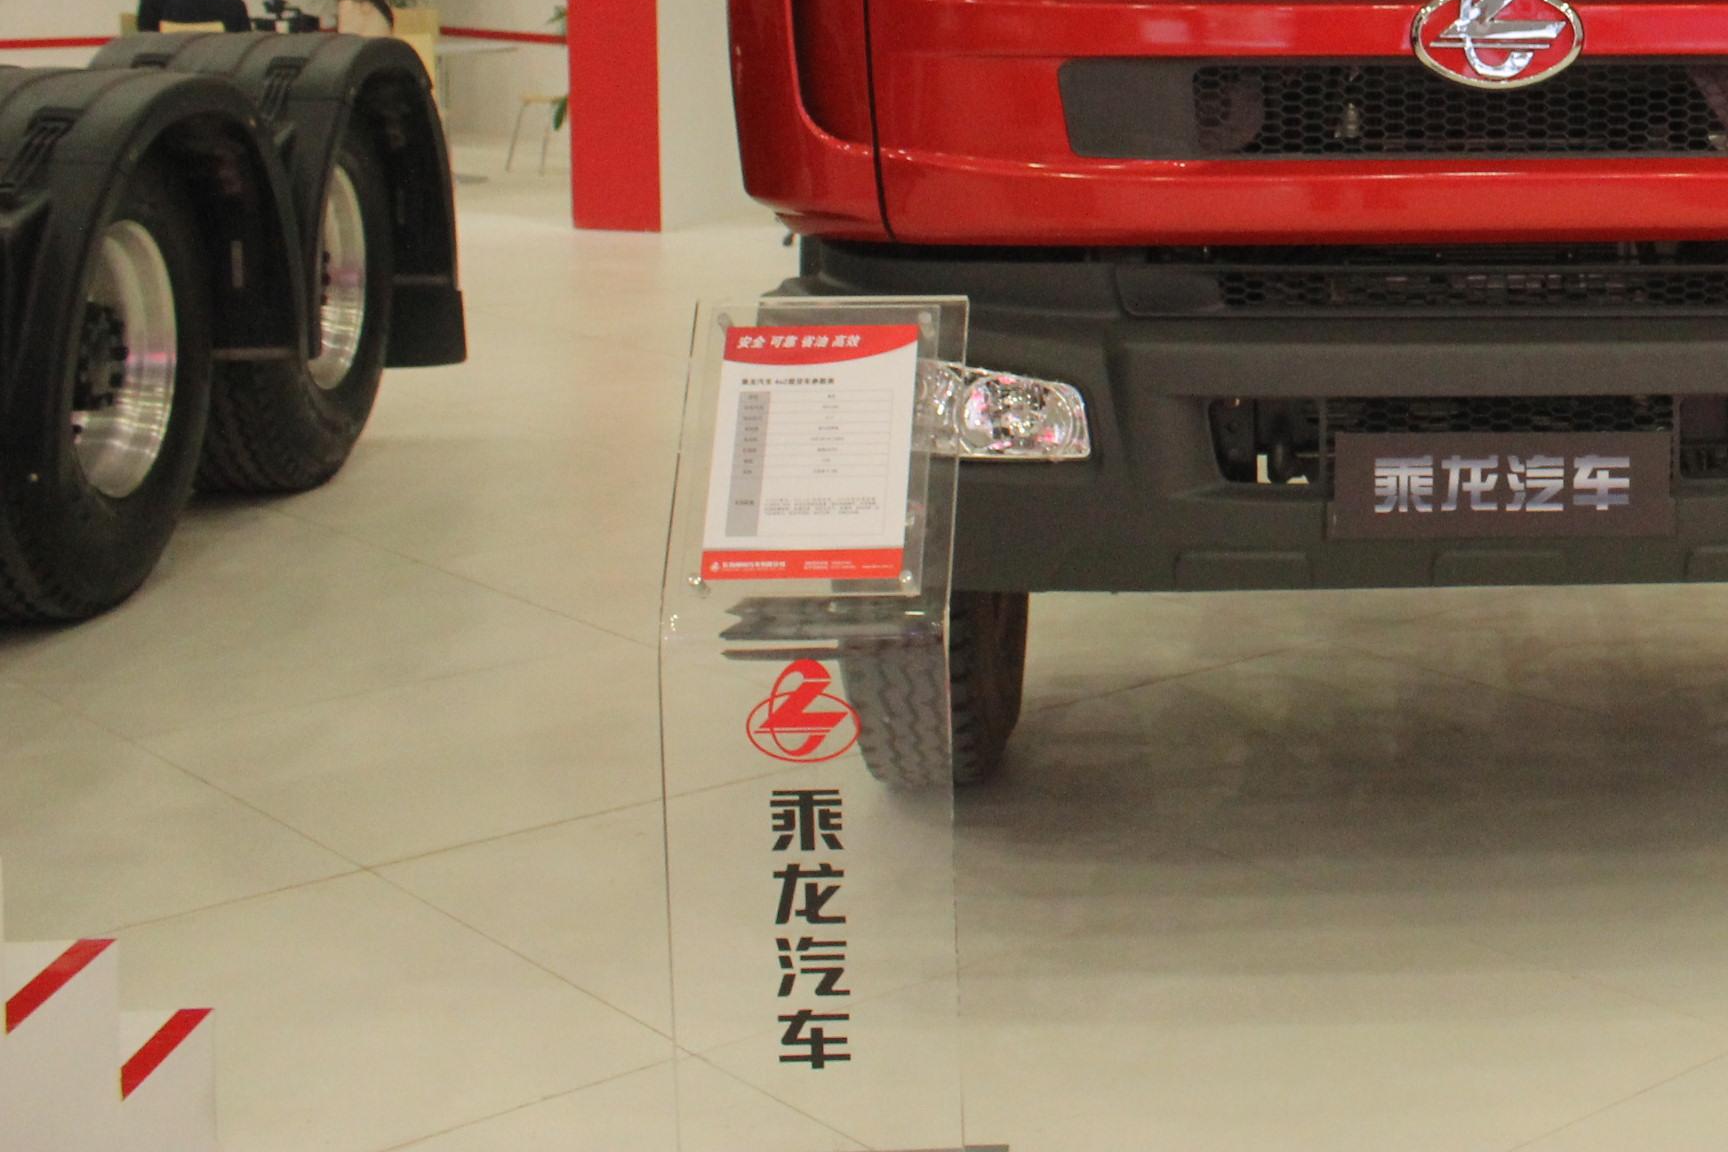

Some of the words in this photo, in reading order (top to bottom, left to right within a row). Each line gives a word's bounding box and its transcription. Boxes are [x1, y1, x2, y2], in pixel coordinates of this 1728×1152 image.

[1374, 455, 1630, 513] 乘龙汽车
[770, 789, 851, 1069] 乘龙汽车
